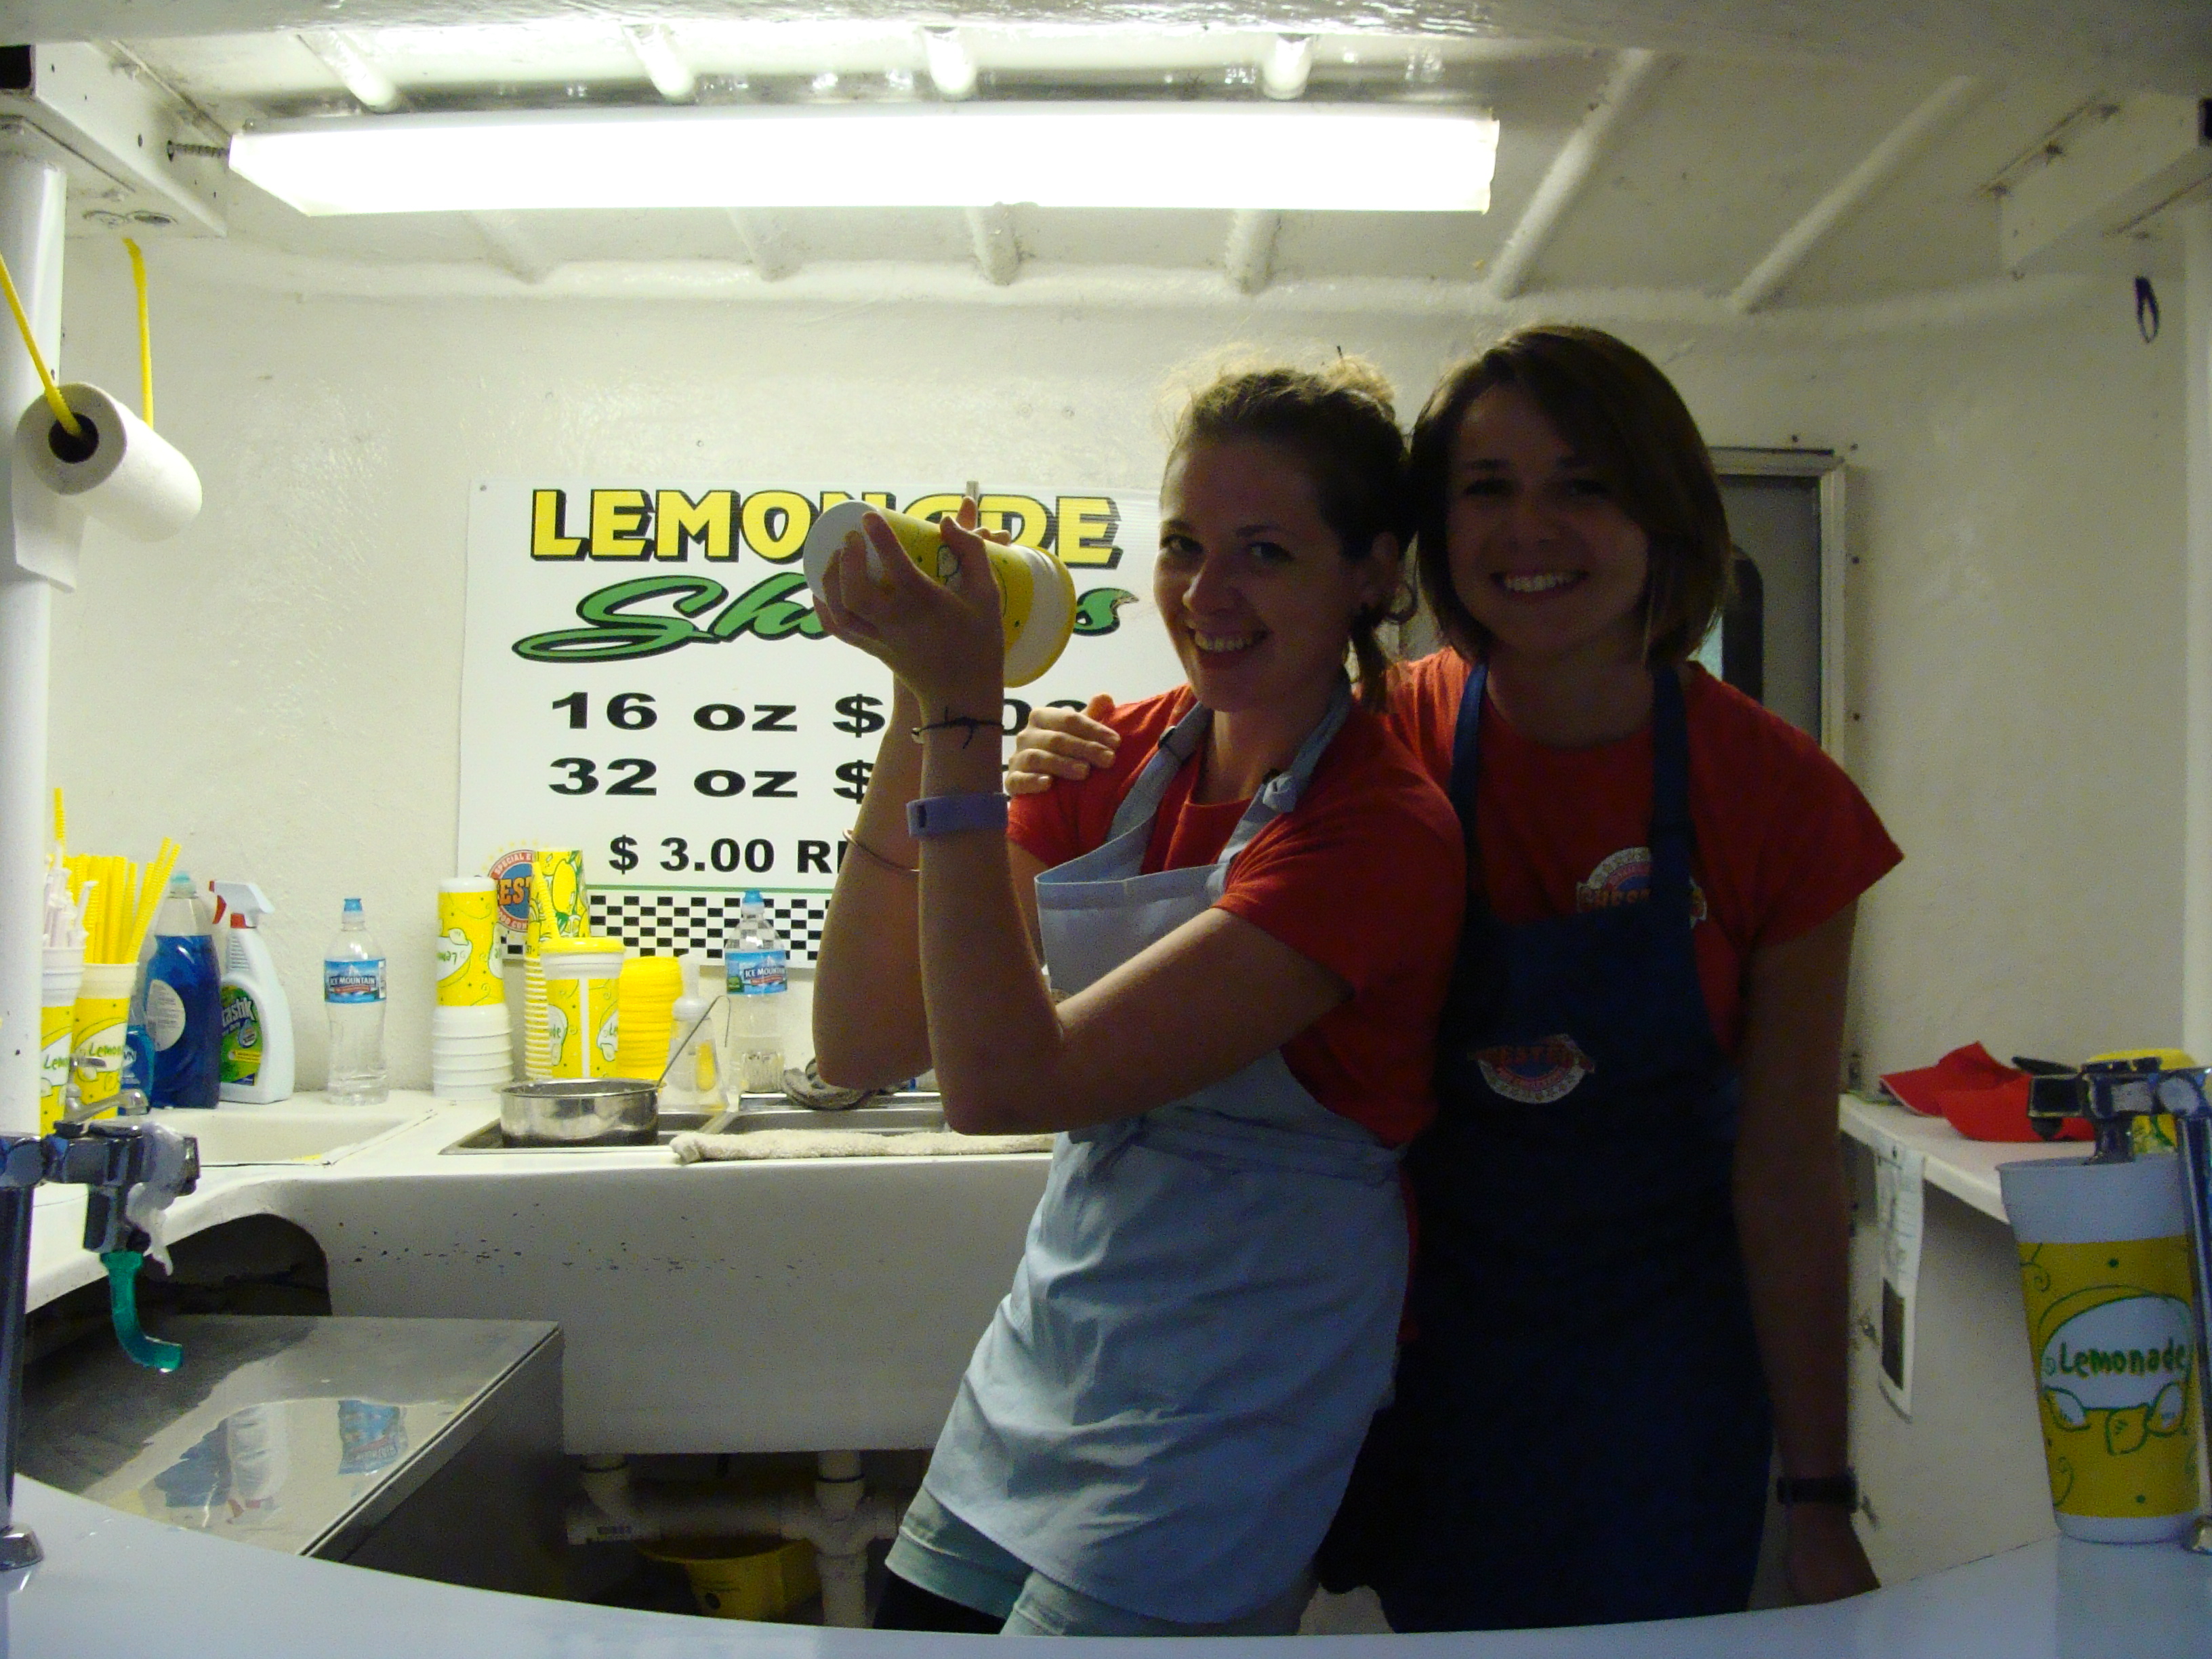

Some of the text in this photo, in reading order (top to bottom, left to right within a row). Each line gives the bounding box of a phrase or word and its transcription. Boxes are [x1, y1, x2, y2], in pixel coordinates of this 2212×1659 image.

[530, 488, 1124, 570] LEMODE
[552, 691, 658, 731] 16
[693, 703, 798, 732] oz
[548, 756, 658, 797] 32
[693, 769, 798, 798] oz
[659, 837, 775, 874] 3.00
[339, 976, 375, 985] MOUNTAIN
[2060, 1336, 2188, 1380] Lemonade
